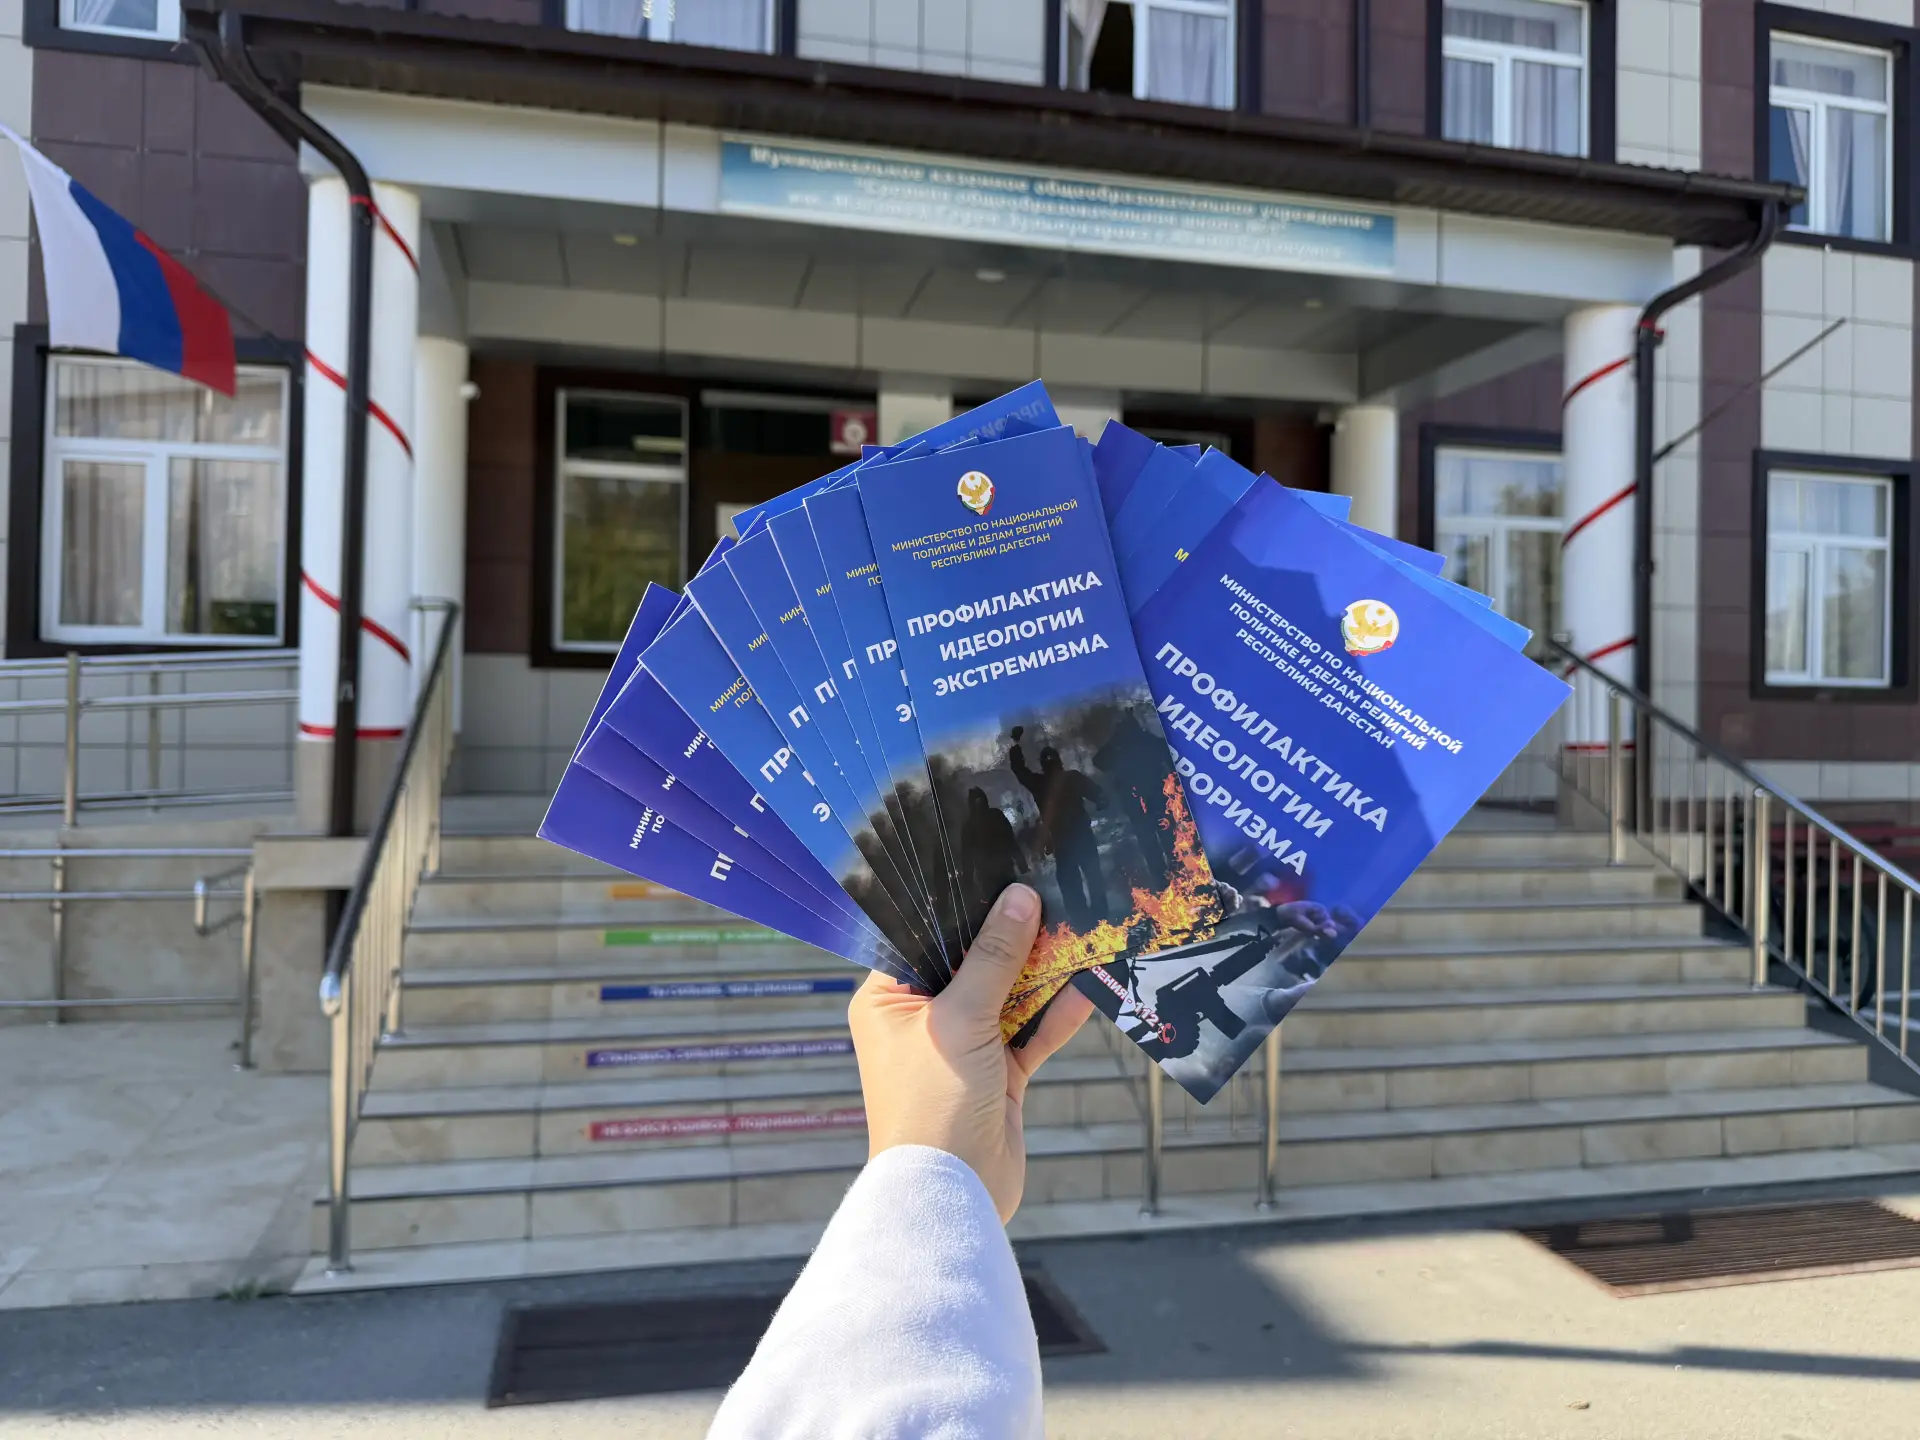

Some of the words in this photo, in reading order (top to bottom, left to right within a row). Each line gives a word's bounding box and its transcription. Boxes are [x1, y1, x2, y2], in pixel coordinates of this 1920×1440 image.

[892, 526, 972, 552] МИНИСТЕРСТВО
[974, 521, 989, 533] ПО
[991, 499, 1079, 528] НАЦИОНАЛЬНОЙ
[913, 541, 967, 560] ПОЛИТИКЕ
[969, 537, 977, 548] И
[978, 528, 1014, 548] ДЕЛАМ
[1016, 516, 1064, 536] РЕЛИГИЙ
[931, 546, 997, 570] РЕСПУБЛИКИ
[999, 533, 1051, 554] ДАГЕСТАН
[906, 570, 1102, 637] ПРОФИЛАКТИКА
[939, 606, 1085, 662] ИДЕОЛОГИИ
[814, 678, 838, 705] П
[932, 633, 1109, 697] ЭКСТРЕМИЗМА
[1219, 574, 1322, 654] МИНИСТЕРСТВО
[1320, 650, 1343, 670] ПО
[1342, 665, 1464, 755] НАЦИОНАЛЬНОЙ
[1228, 602, 1301, 660] ПОЛИТИКЕ
[1298, 655, 1313, 668] И
[1310, 663, 1362, 706] ДЕЛАМ
[1360, 699, 1429, 751] РЕЛИГИЙ
[1235, 628, 1323, 697] РЕСПУБЛИКИ
[1320, 691, 1396, 749] ДАГЕСТАН
[760, 744, 794, 783] ПР
[1154, 641, 1390, 833] ПРОФИЛАКТИКА
[1156, 694, 1335, 838] ИДЕОЛОГИИ
[710, 852, 735, 881] П
[1091, 965, 1129, 1001] СЕНИЯ
[1134, 1001, 1160, 1028] 112
